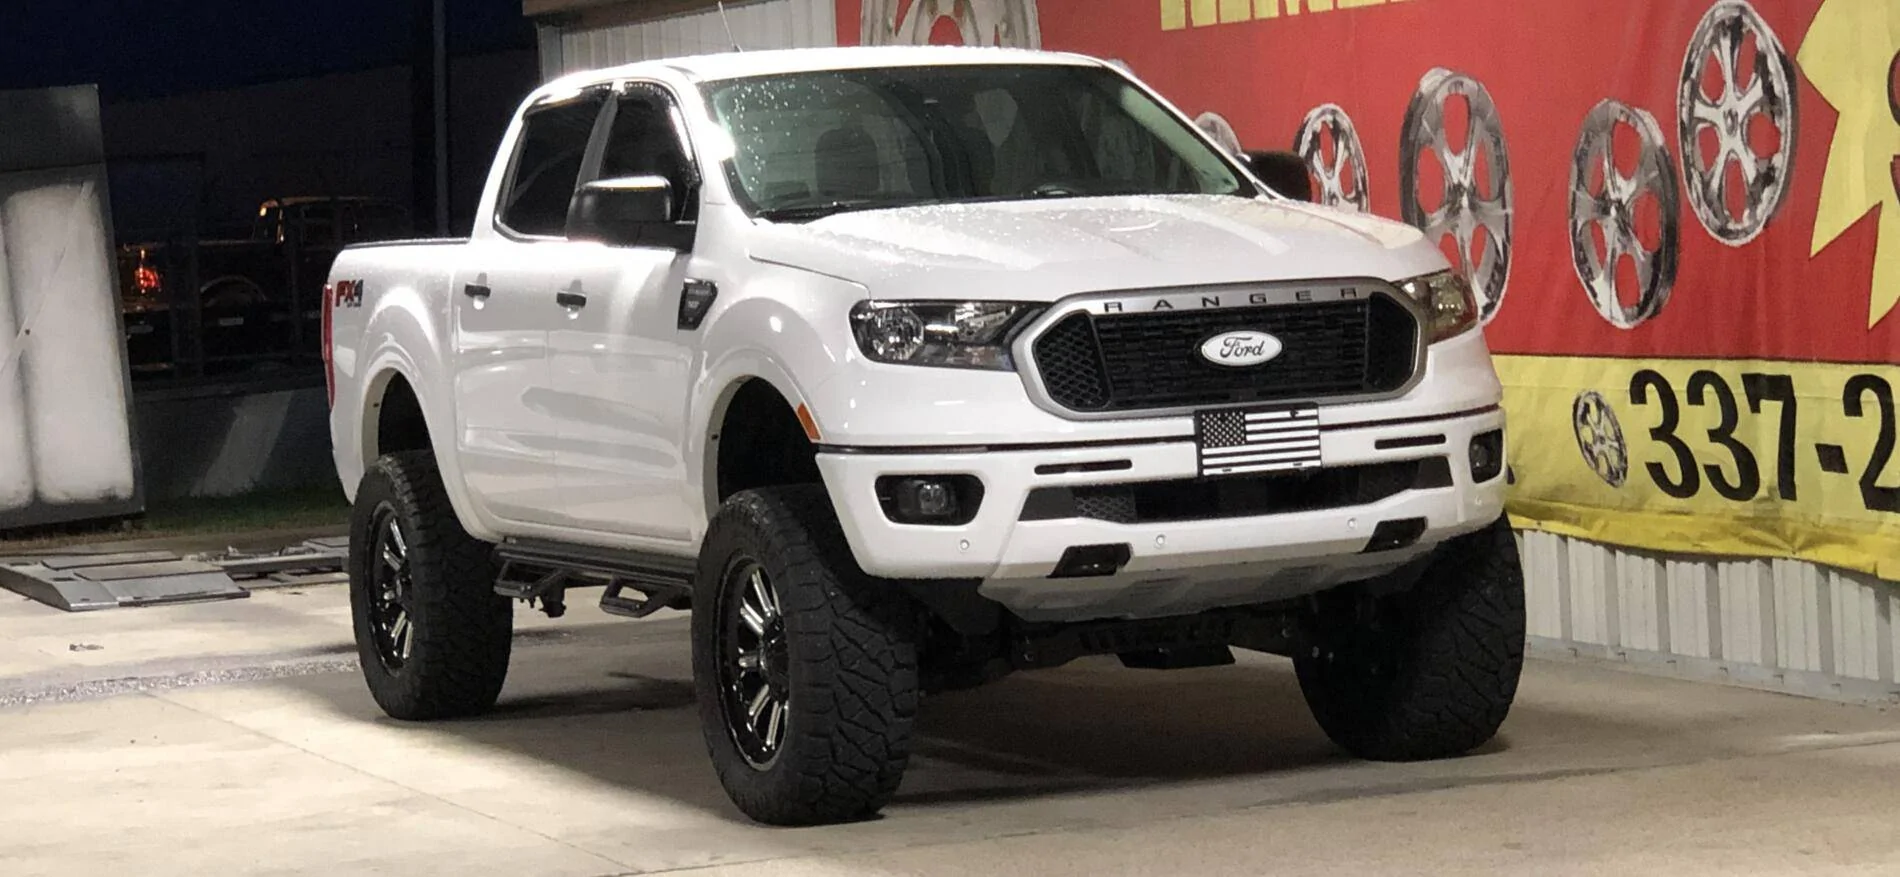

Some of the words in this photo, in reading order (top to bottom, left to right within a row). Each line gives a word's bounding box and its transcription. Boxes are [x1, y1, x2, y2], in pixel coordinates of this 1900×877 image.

[335, 279, 364, 307] FX4
[1104, 287, 1357, 313] RANGER
[1219, 336, 1265, 359] Ford
[1629, 368, 1900, 514] 337-2
